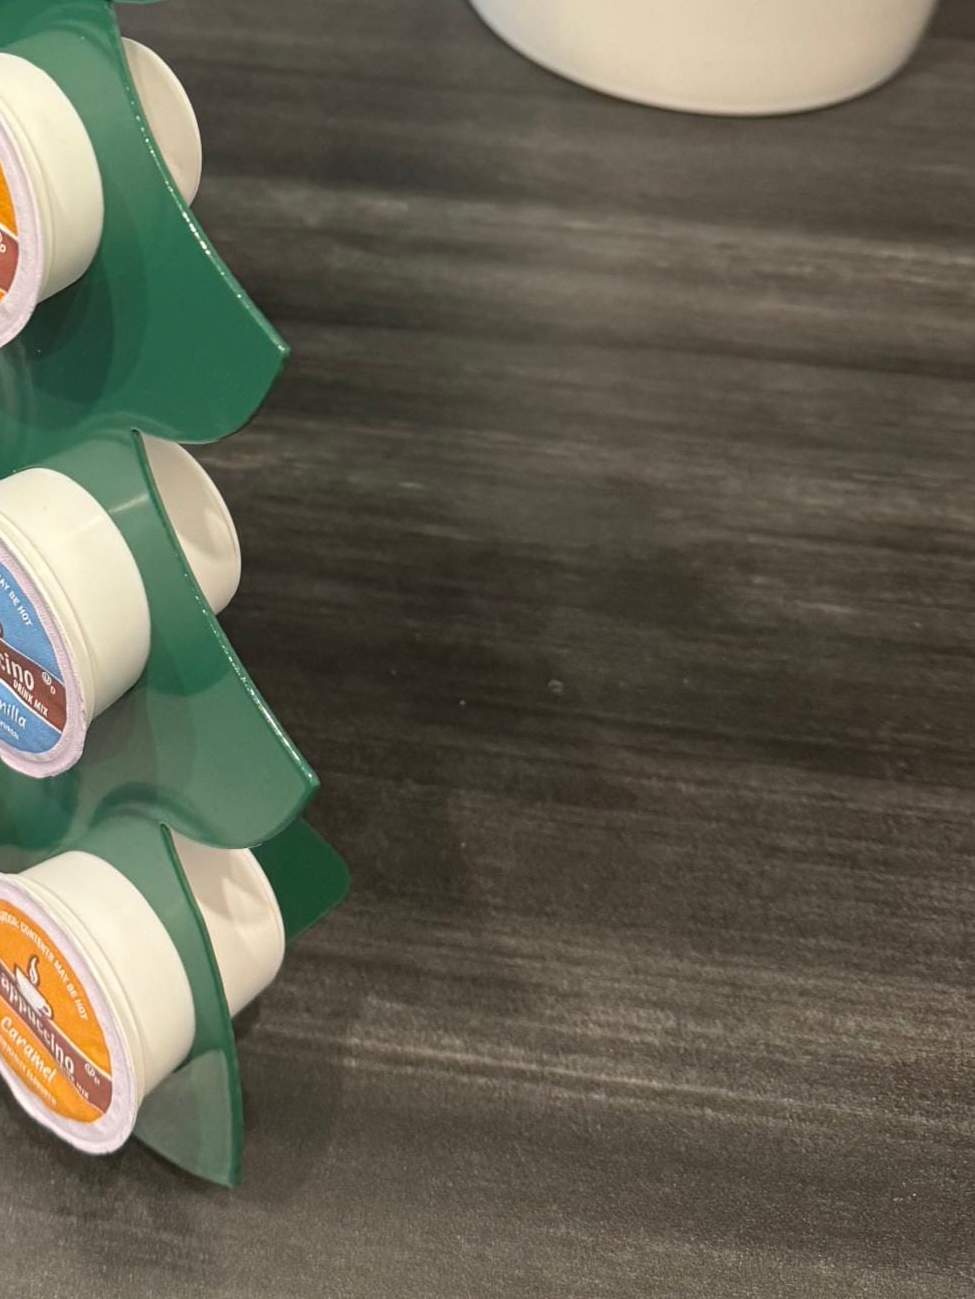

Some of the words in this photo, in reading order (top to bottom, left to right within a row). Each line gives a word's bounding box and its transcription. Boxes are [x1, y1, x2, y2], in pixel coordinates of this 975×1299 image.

[17, 604, 33, 626] HOT
[13, 681, 34, 707] DRINK
[33, 698, 48, 718] MIX
[19, 921, 54, 962] CONTENTS
[53, 956, 69, 981] MAY
[66, 980, 78, 999] BE
[74, 998, 88, 1021] HOT
[0, 1016, 57, 1082] Caramel
